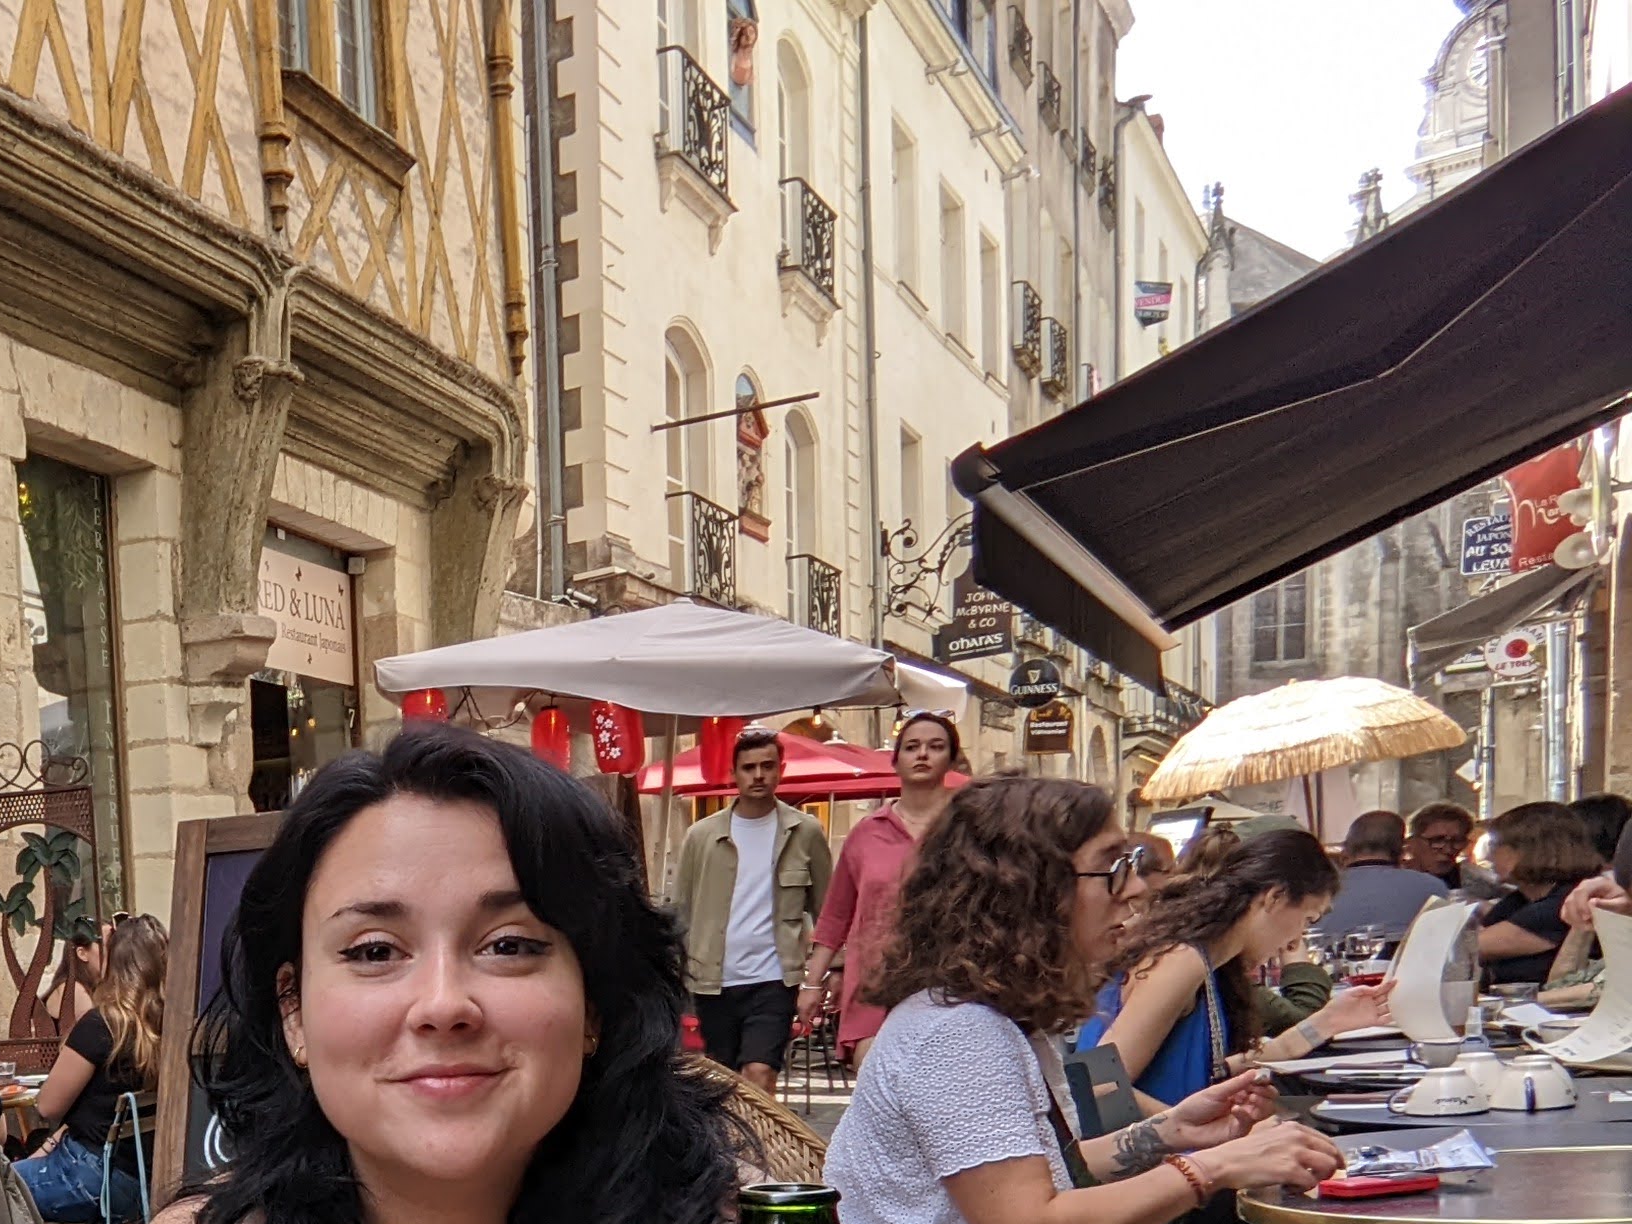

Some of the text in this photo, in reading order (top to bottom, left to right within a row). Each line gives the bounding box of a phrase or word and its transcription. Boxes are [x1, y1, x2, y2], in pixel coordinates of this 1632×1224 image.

[1466, 515, 1511, 537] RESTAU
[1476, 532, 1511, 543] JAPON
[1466, 545, 1485, 558] AU
[90, 475, 110, 668] TERRASSE
[1473, 558, 1511, 572] LEVA
[965, 591, 1000, 603] JOHN
[290, 588, 301, 618] &
[303, 592, 345, 630] LUNA
[956, 601, 1010, 617] McBYRNE
[968, 617, 996, 629] & CO
[281, 621, 317, 646] Restaurant
[1011, 683, 1058, 696] GUINNESS
[349, 708, 355, 729] 7
